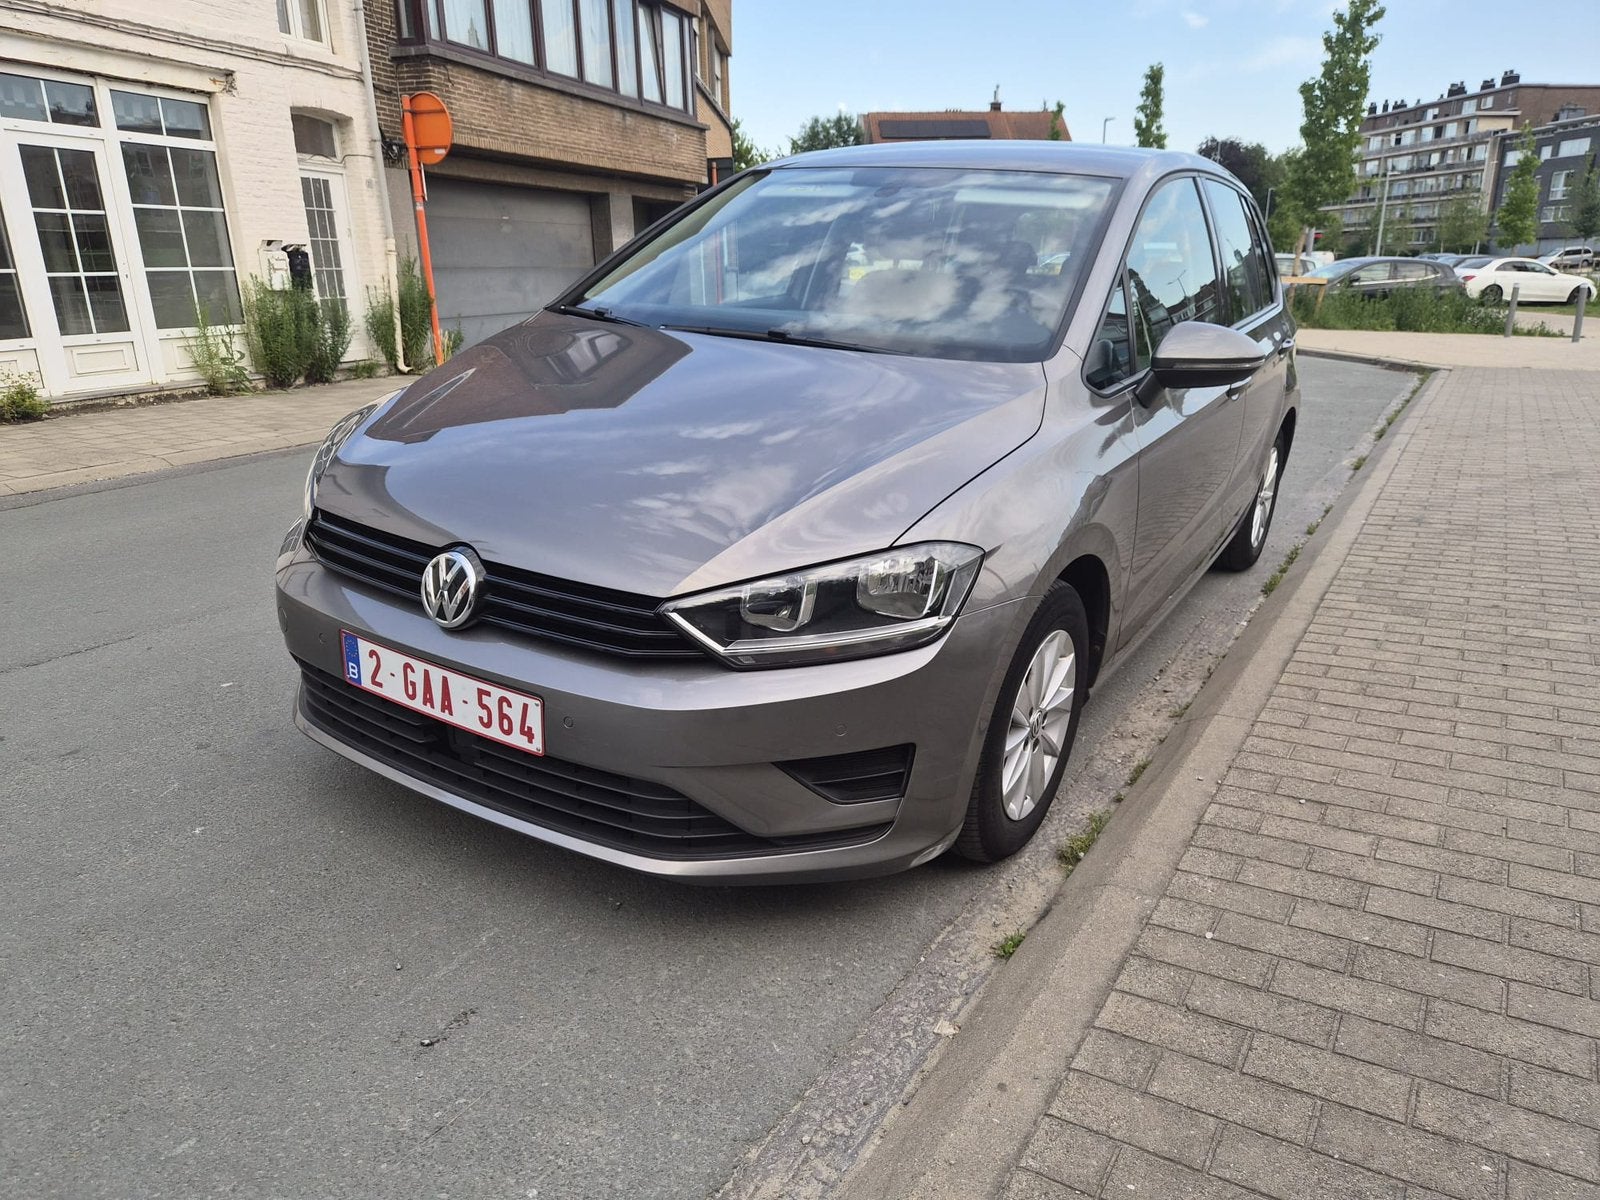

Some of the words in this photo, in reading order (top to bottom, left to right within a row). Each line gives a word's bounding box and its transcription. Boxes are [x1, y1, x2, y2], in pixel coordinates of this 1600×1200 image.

[423, 553, 473, 625] VW
[349, 662, 358, 678] B
[368, 649, 535, 744] 2-GAA-564
